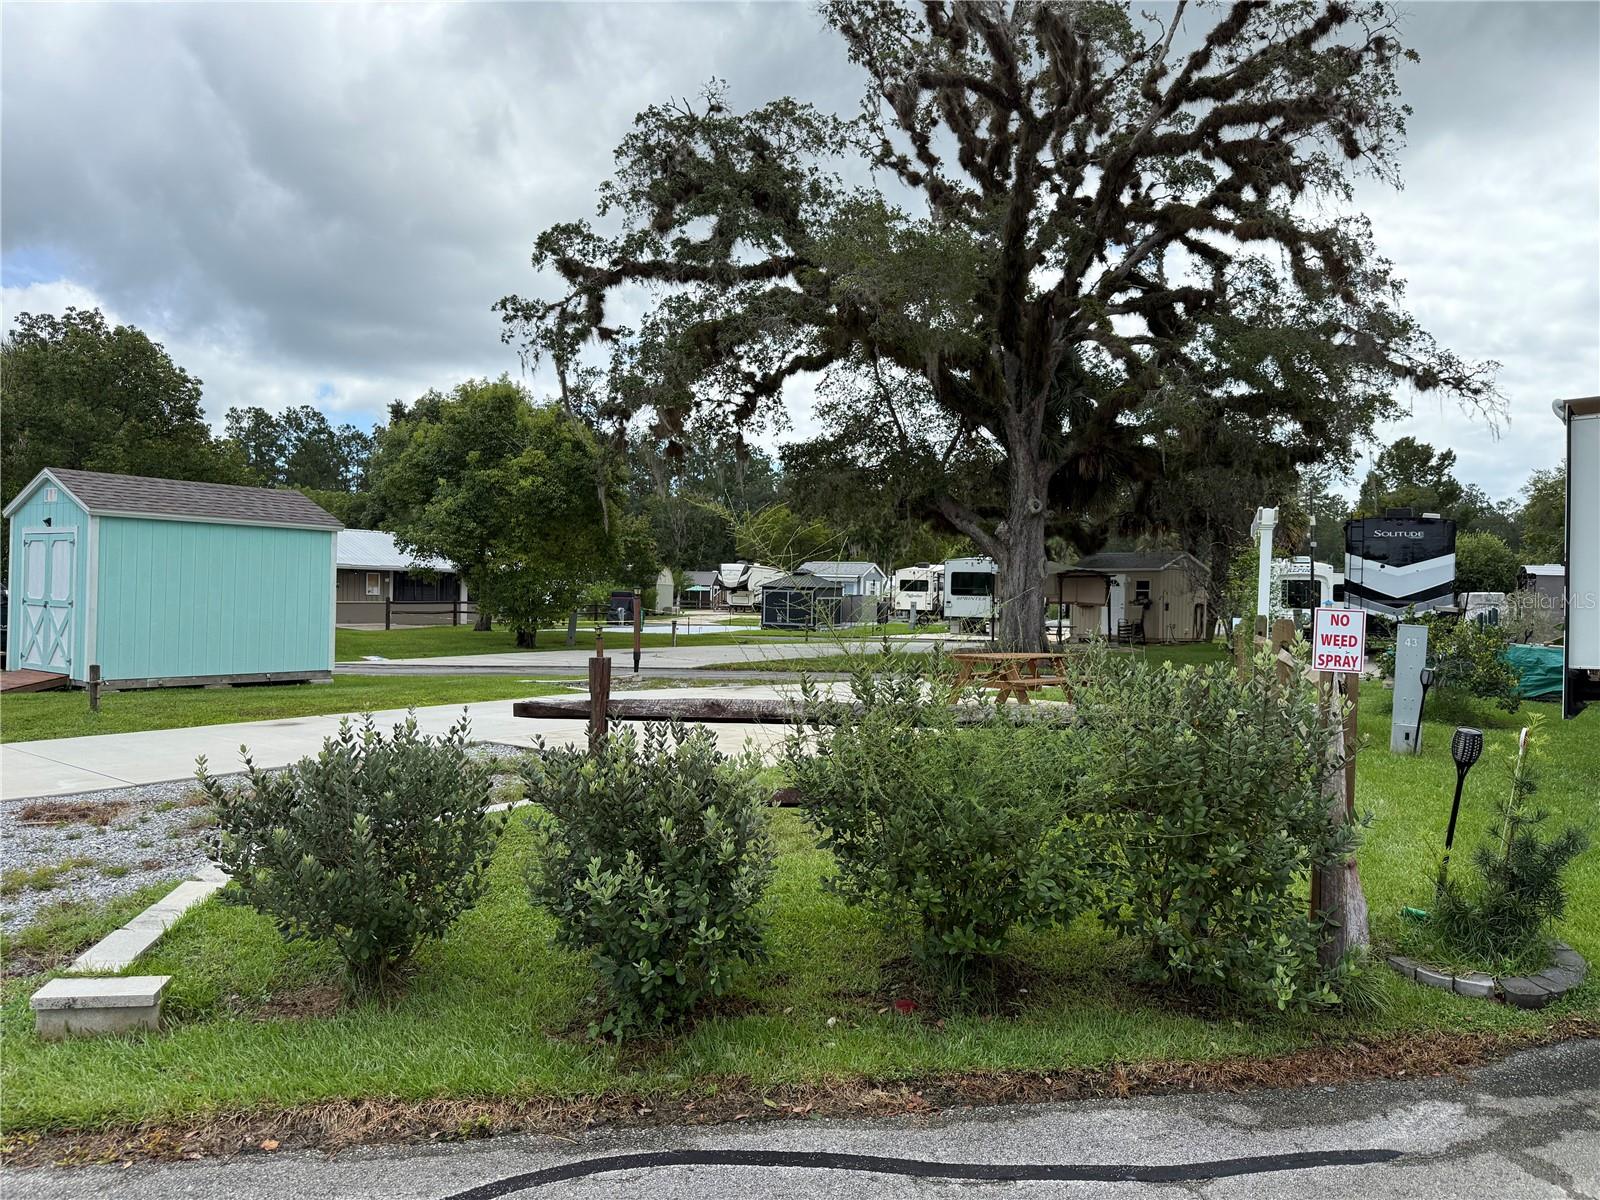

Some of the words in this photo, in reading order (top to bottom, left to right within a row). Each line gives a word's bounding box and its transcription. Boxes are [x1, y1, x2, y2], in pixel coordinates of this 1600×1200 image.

[1330, 614, 1350, 627] NO
[1321, 634, 1358, 648] WEED
[1317, 653, 1359, 668] SPRAY
